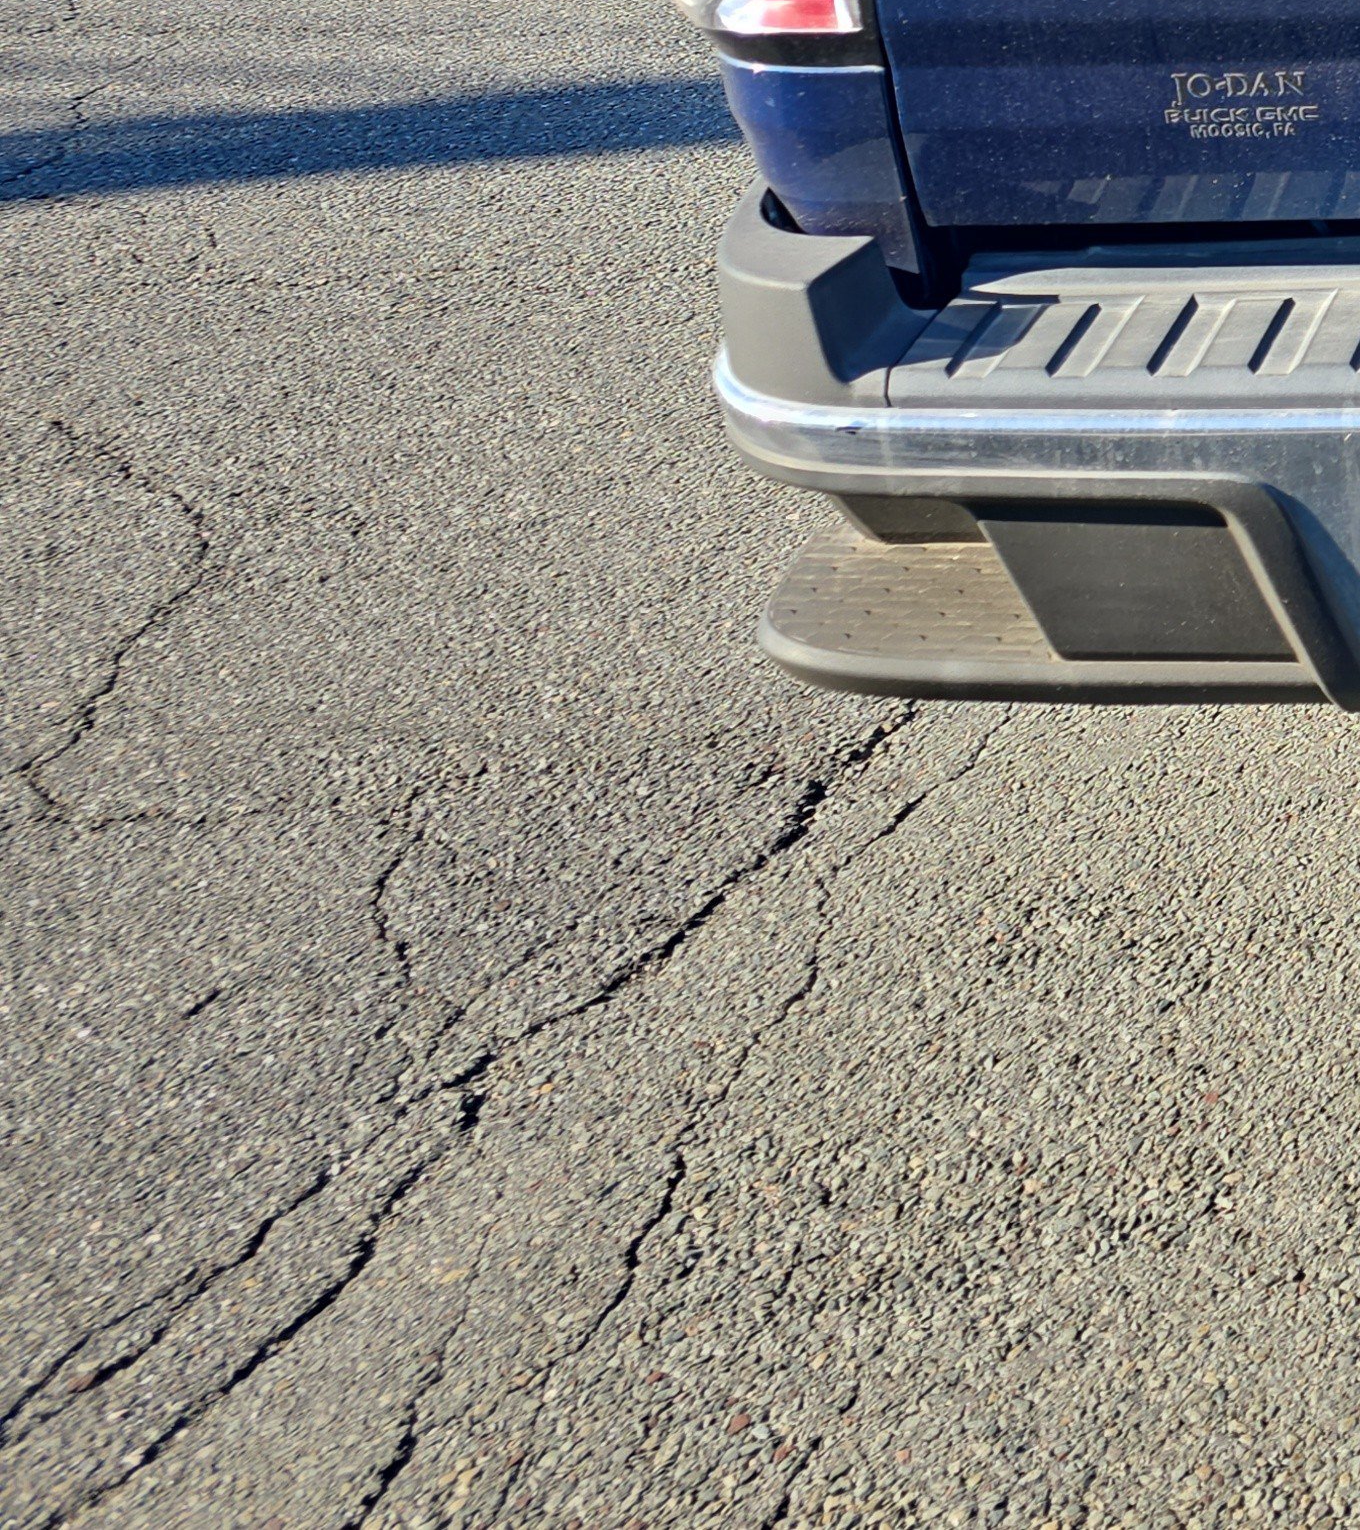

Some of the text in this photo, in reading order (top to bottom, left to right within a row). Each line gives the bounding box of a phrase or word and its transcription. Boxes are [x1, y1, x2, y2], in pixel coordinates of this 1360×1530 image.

[1171, 72, 1305, 107] JO-DAN
[1164, 105, 1319, 123] BUICK GMC
